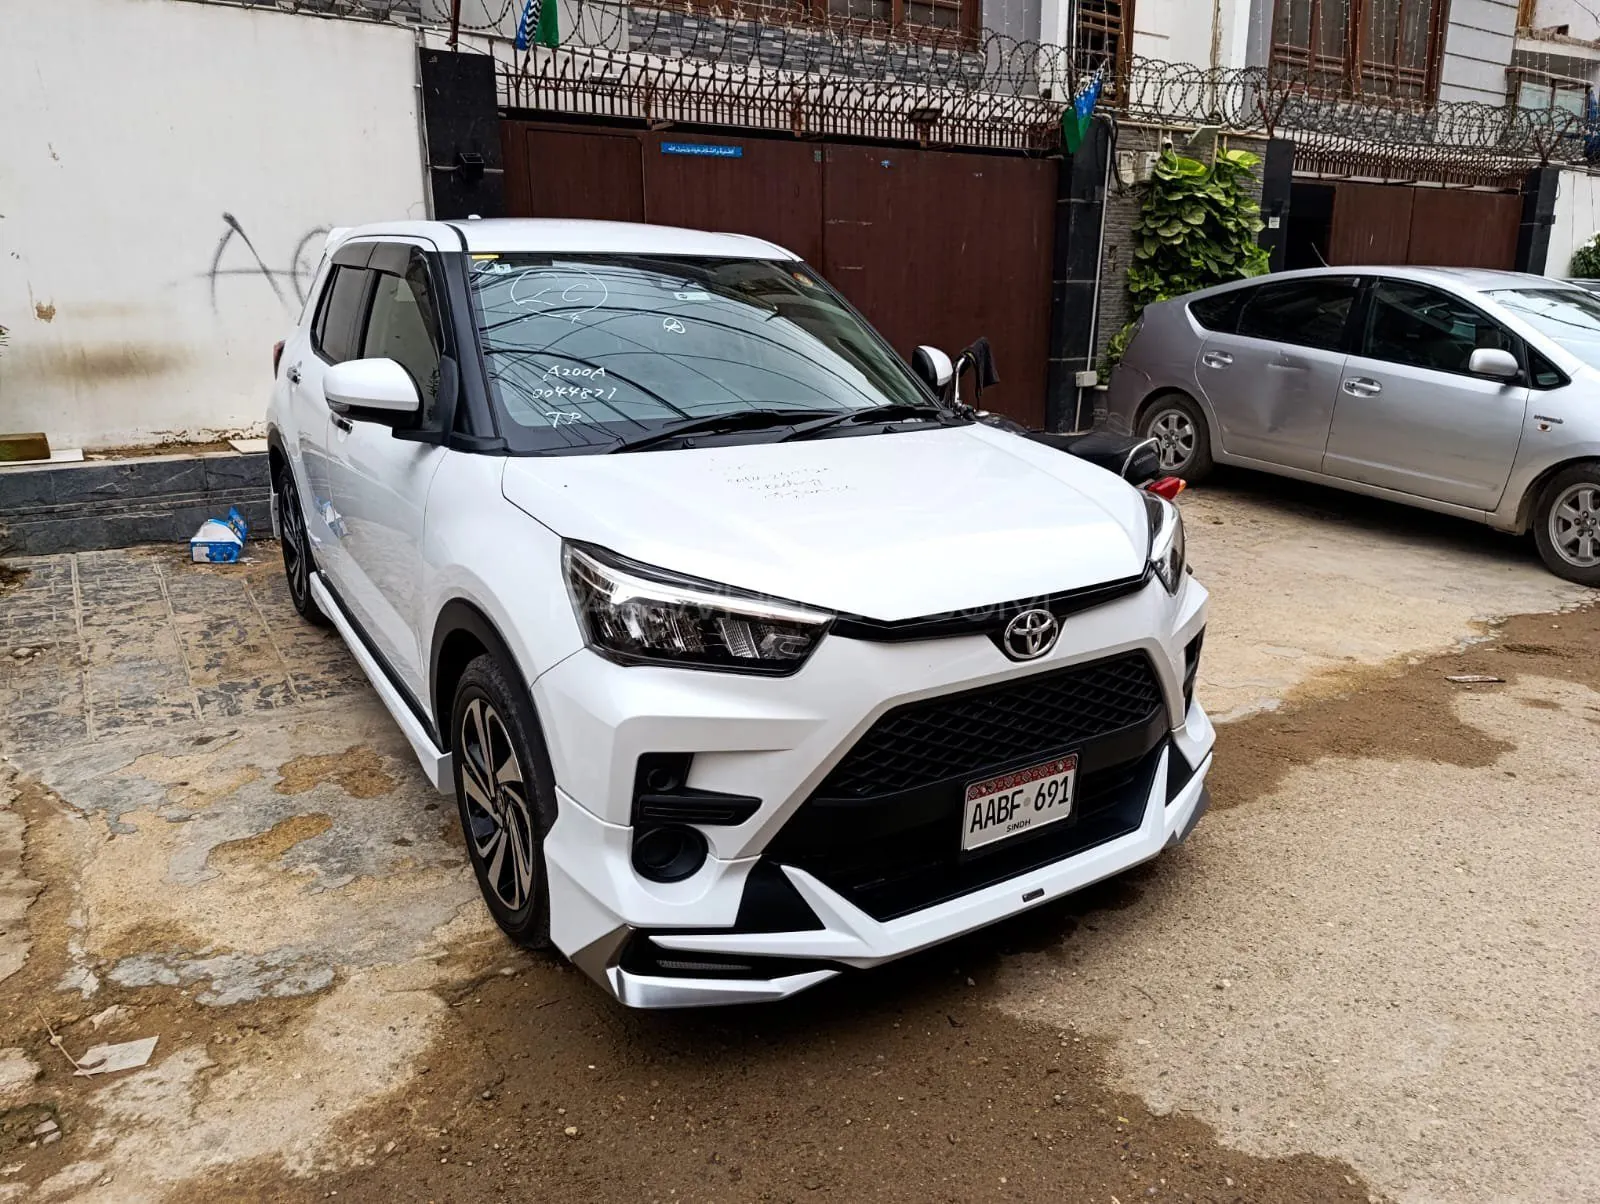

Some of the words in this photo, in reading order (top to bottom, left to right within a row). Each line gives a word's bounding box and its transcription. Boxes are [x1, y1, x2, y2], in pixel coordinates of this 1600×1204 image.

[542, 365, 606, 382] A200A
[970, 789, 1024, 833] AABF
[1034, 776, 1069, 811] 691
